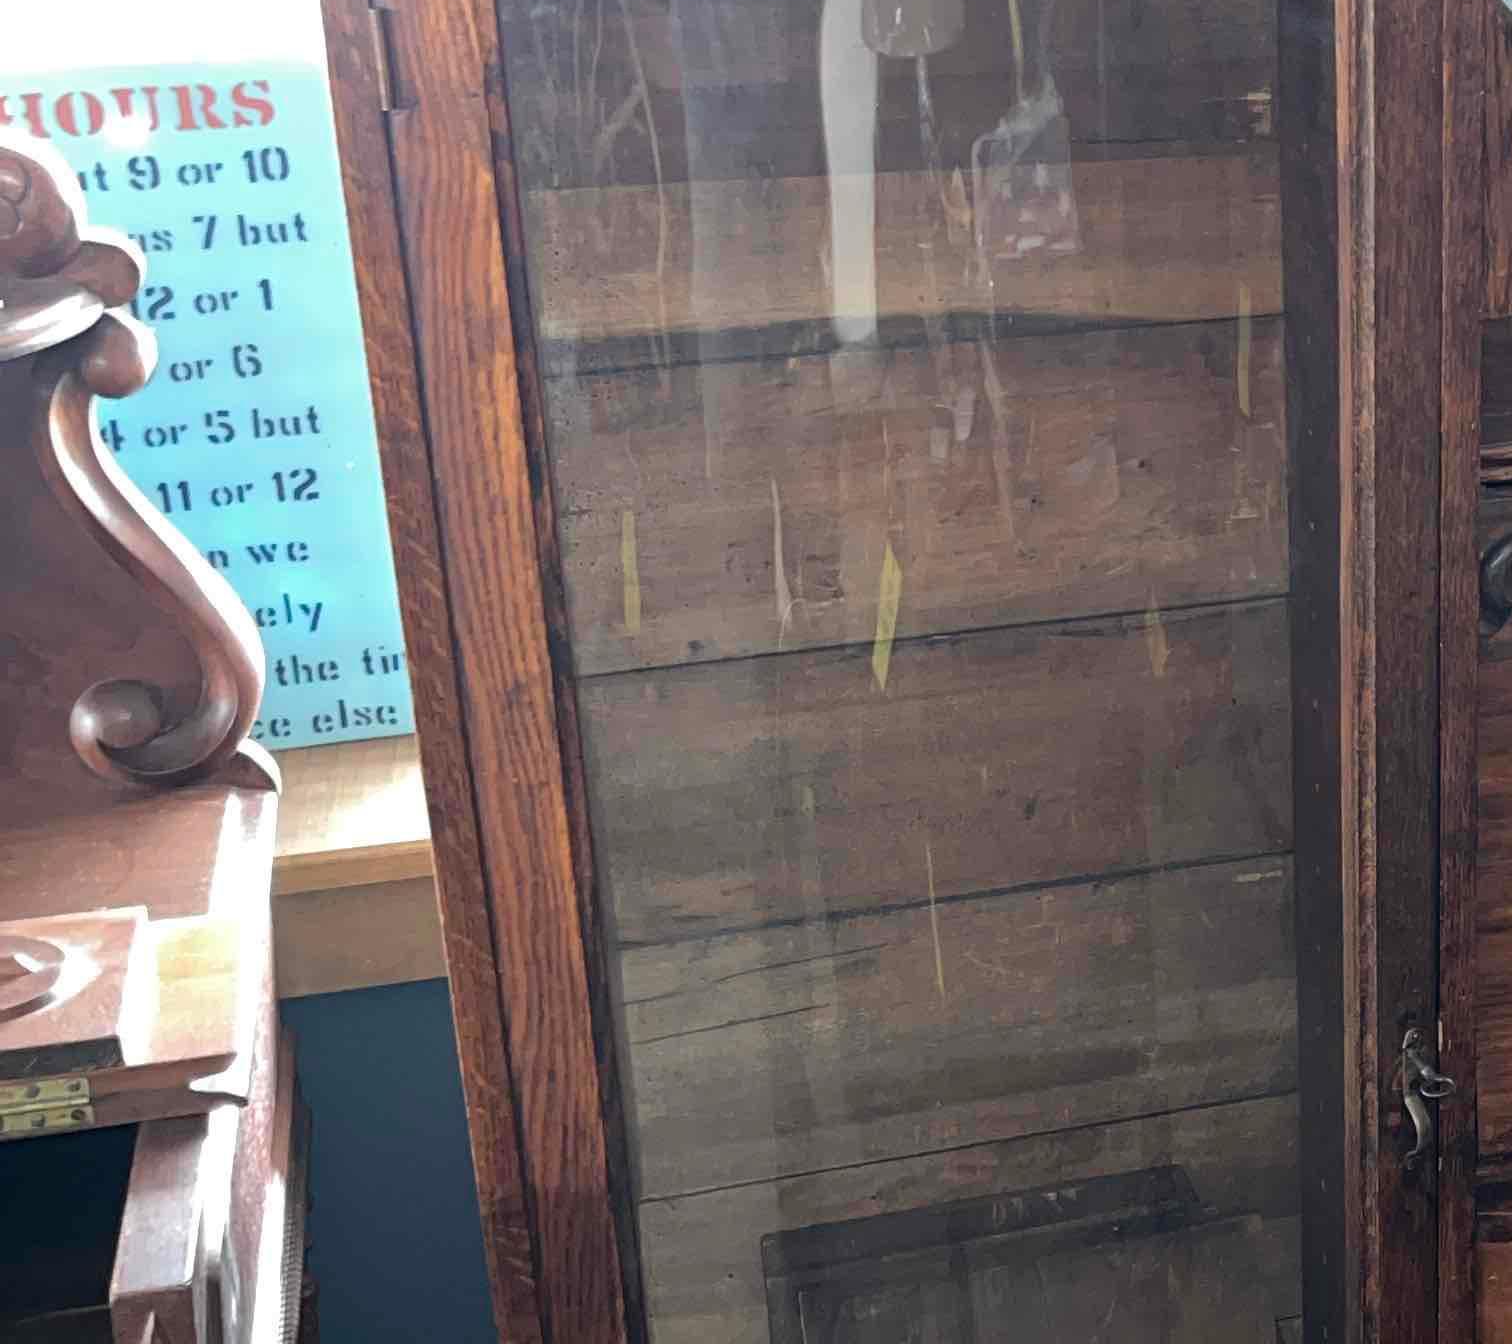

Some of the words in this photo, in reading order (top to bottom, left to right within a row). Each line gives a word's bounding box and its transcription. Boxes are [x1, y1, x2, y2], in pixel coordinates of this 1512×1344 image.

[127, 155, 161, 191] 9
[176, 161, 224, 186] or
[242, 146, 290, 184] 10
[192, 215, 217, 250] 7
[237, 212, 309, 247] but
[193, 289, 239, 315] or
[256, 278, 274, 311] 1
[169, 358, 214, 383] or
[231, 343, 263, 379] 6
[143, 423, 188, 448] or
[204, 409, 236, 445] 5
[251, 405, 321, 439] but
[156, 480, 193, 514] 11
[210, 482, 254, 508] or
[271, 467, 320, 502] 12
[246, 541, 310, 565] we
[254, 592, 323, 633] ely
[274, 655, 341, 688] the
[311, 698, 399, 735] else
